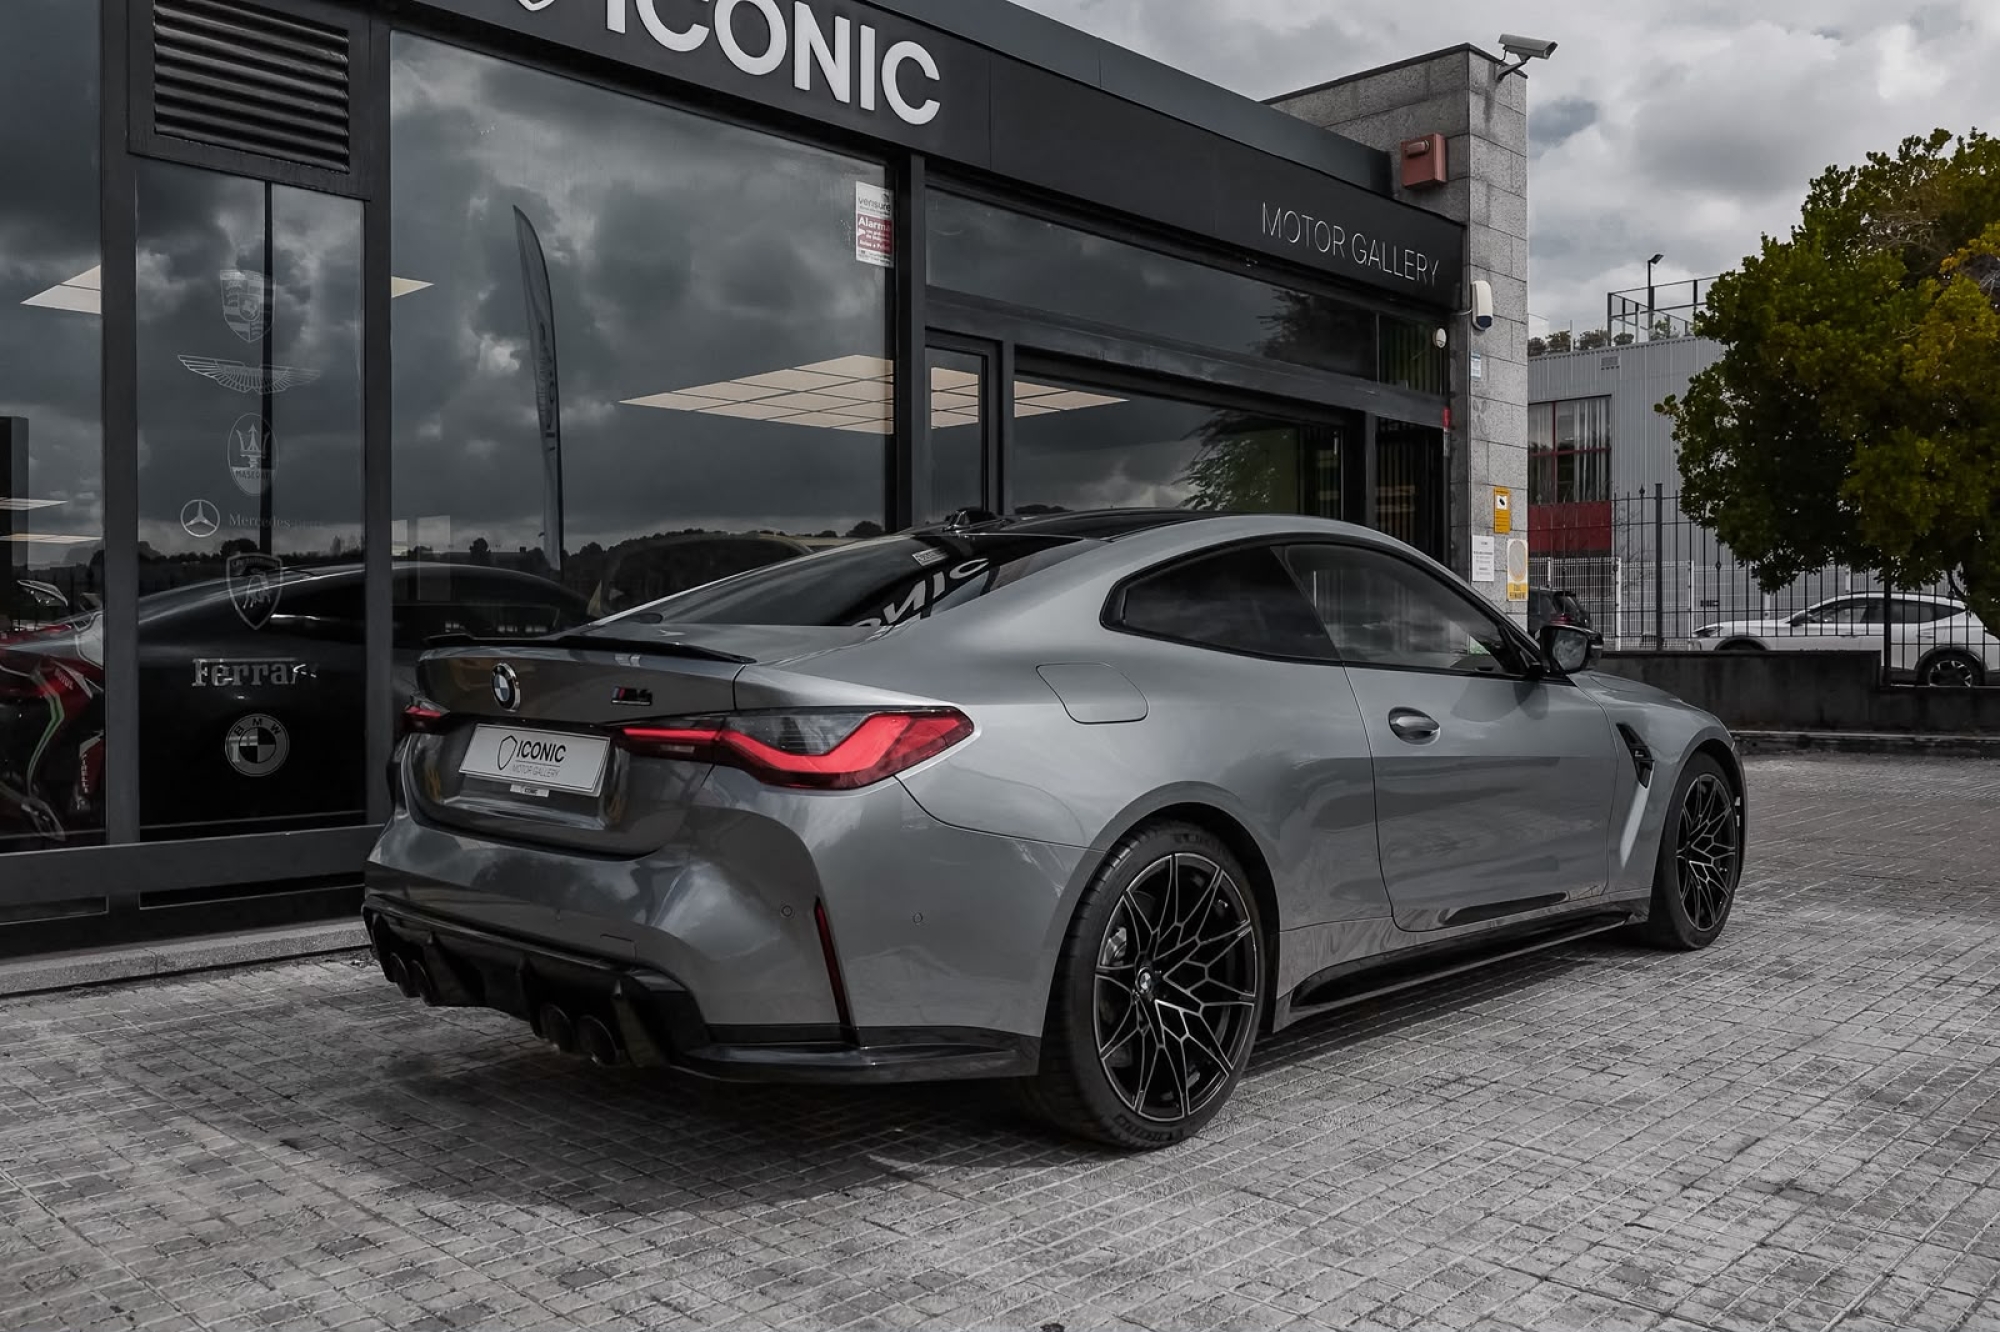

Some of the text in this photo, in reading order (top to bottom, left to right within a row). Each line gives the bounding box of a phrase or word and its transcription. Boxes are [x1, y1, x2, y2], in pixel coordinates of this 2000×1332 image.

[858, 216, 891, 231] Alarma
[1261, 201, 1440, 287] MOTOR GALLERY
[234, 718, 281, 736] BMW
[517, 740, 566, 763] ICONIC
